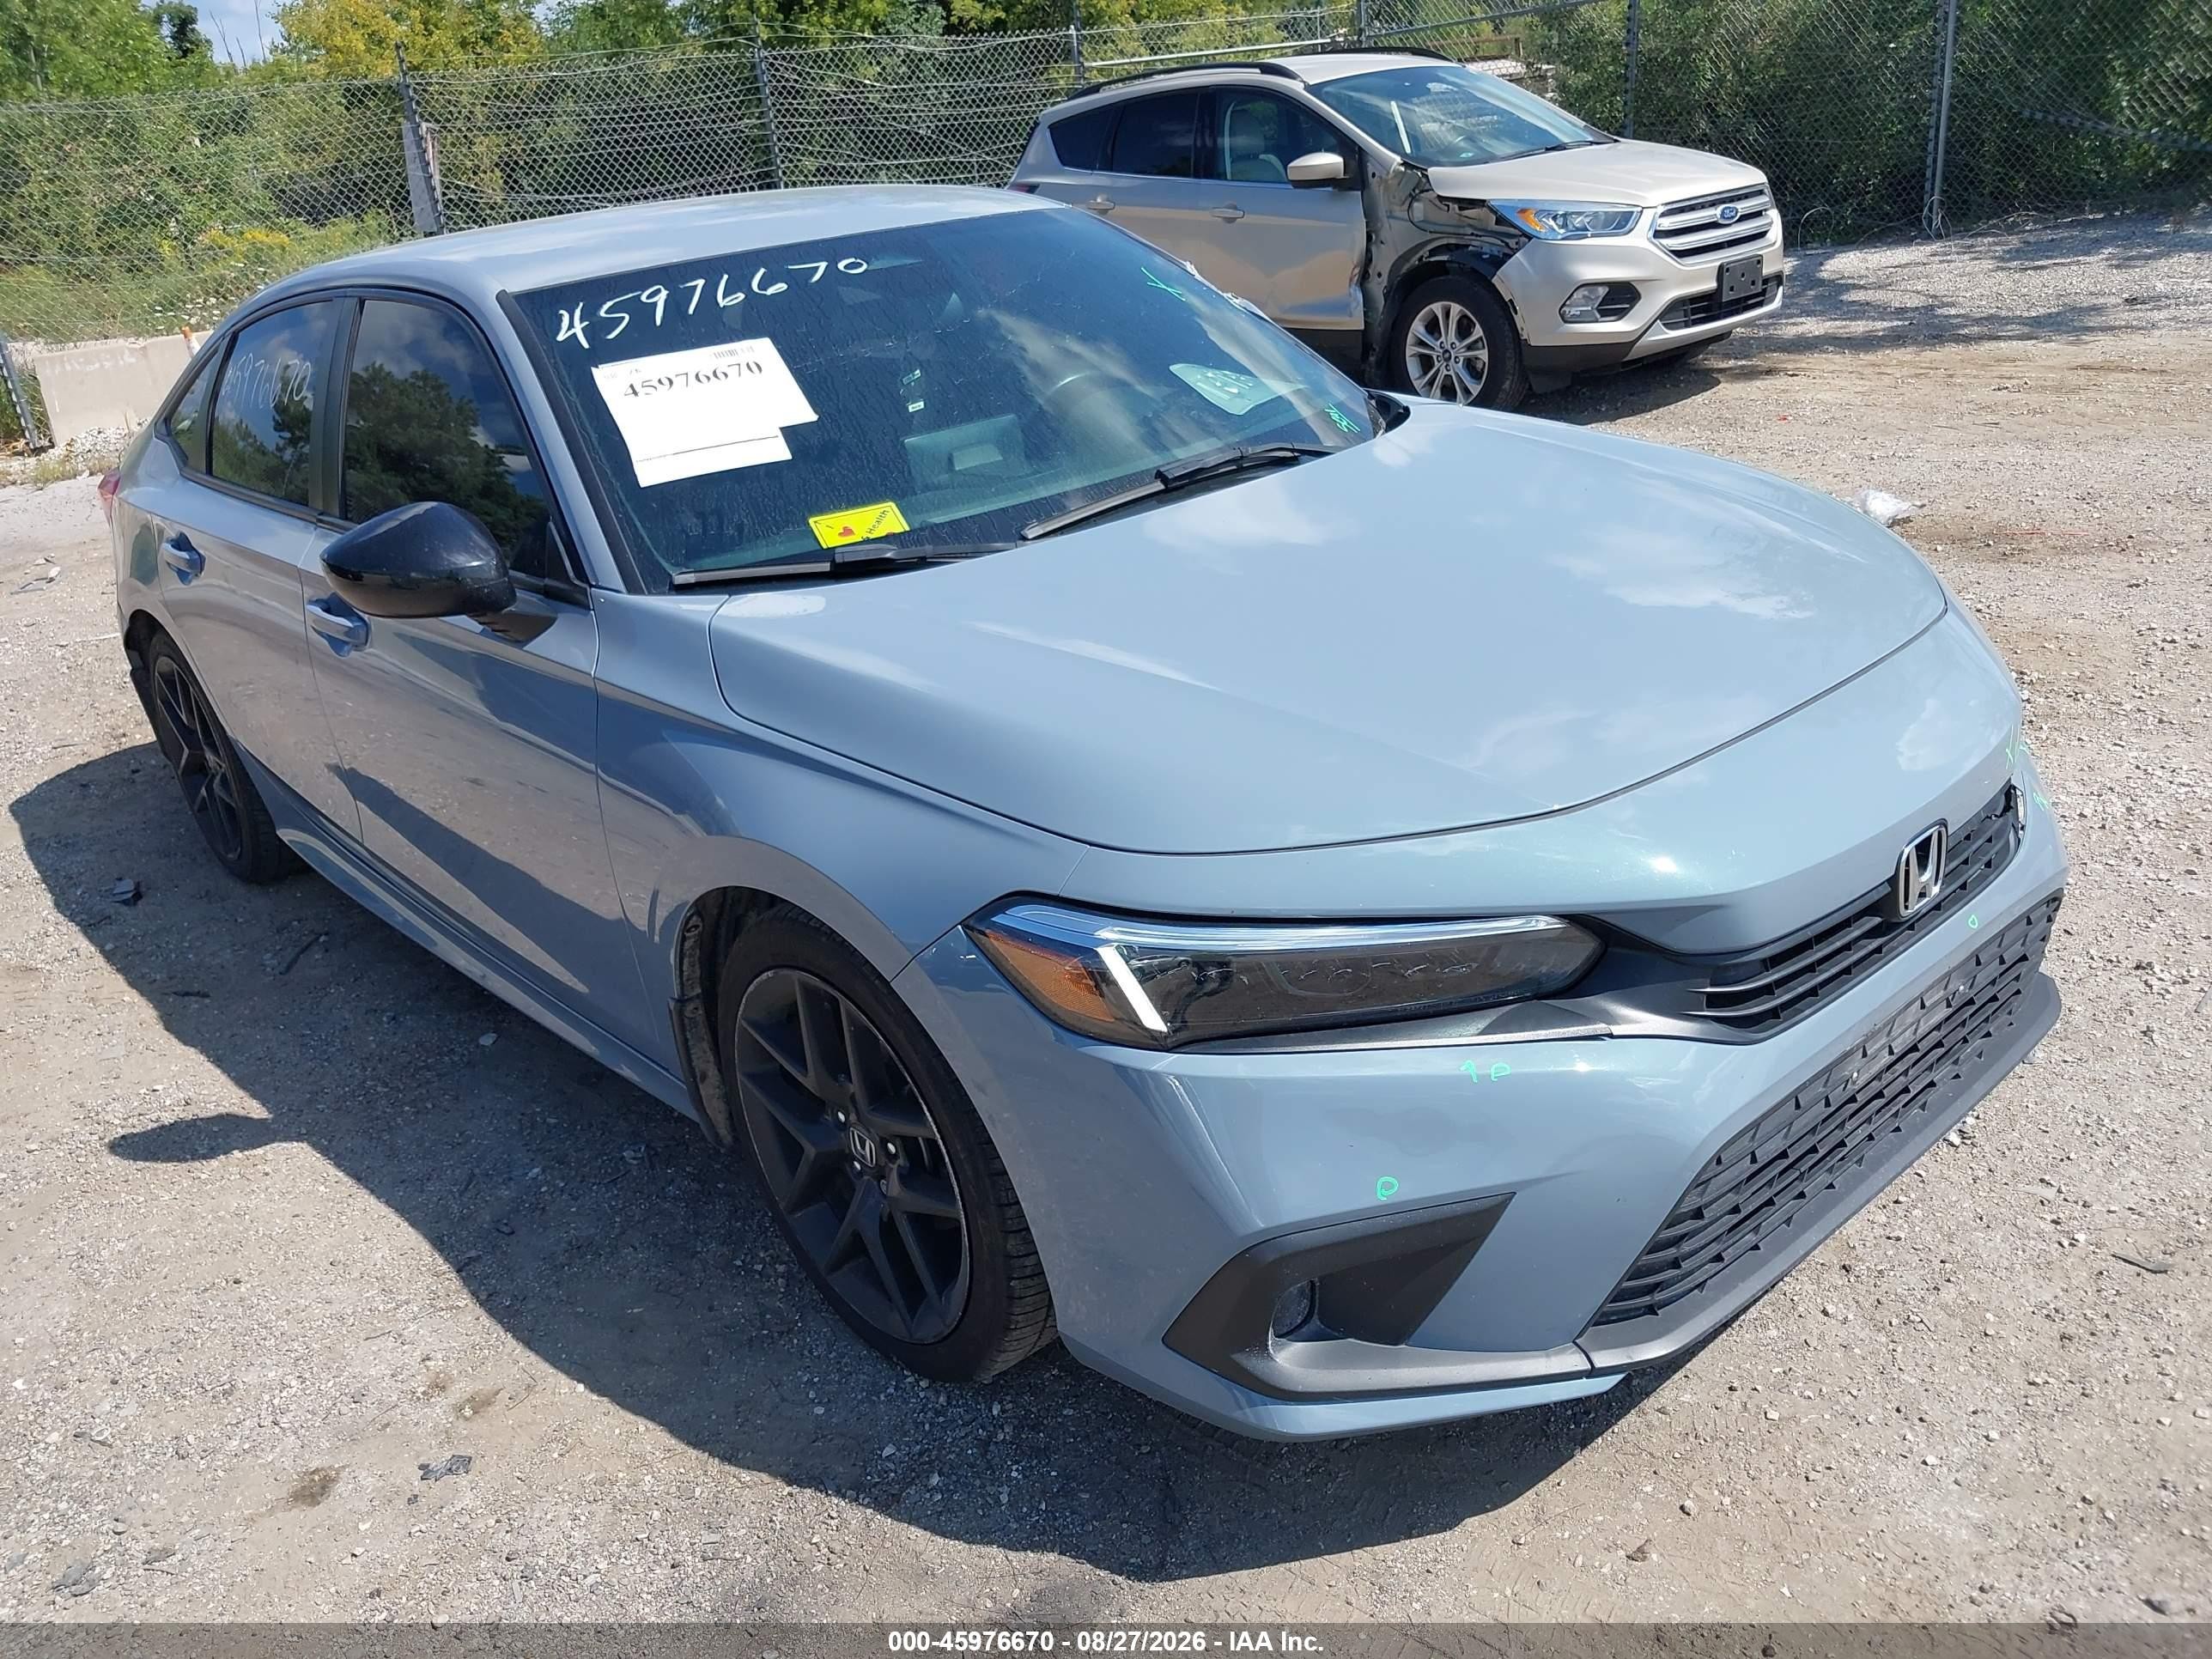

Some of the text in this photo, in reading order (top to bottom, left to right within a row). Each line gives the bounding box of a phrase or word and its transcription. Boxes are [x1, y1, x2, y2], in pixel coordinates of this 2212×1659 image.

[556, 257, 868, 350] 45976670
[623, 360, 763, 398] 45976670
[865, 508, 890, 535] Health
